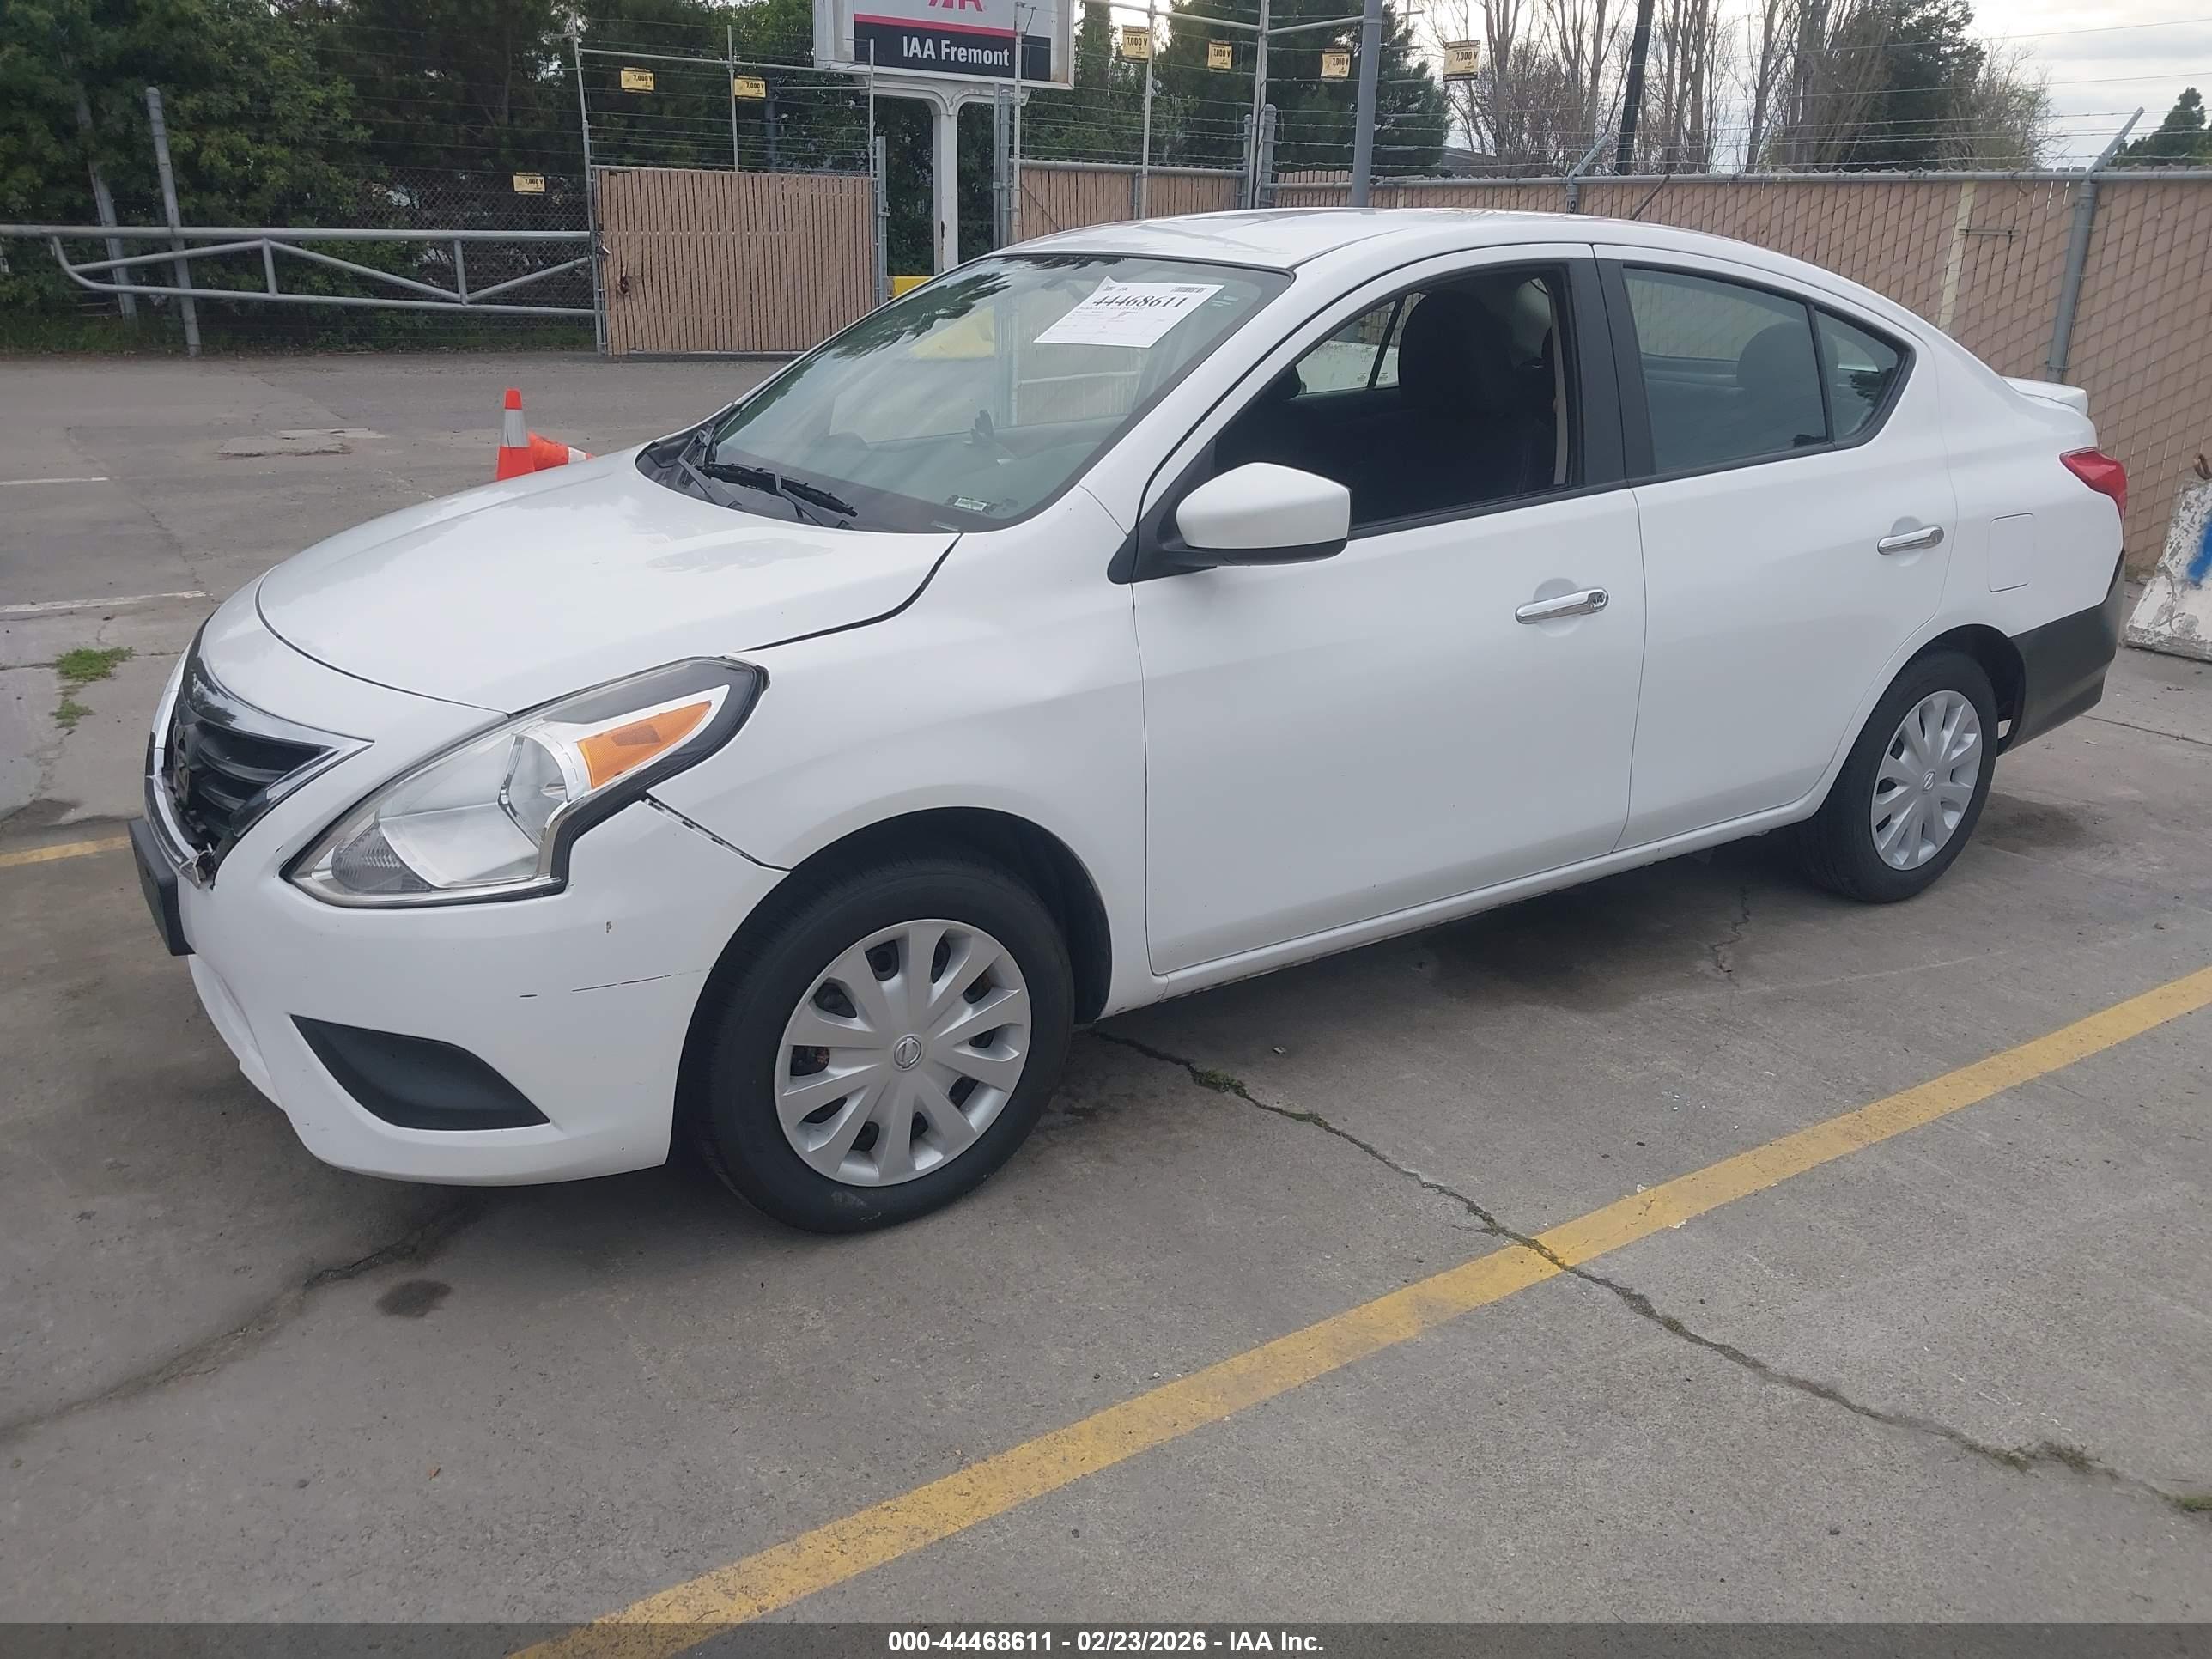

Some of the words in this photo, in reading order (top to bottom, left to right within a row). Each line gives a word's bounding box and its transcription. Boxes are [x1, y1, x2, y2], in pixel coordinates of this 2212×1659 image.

[902, 36, 936, 60] IAA
[941, 40, 1010, 67] Fremont
[1332, 57, 1346, 66] 7,000
[1455, 52, 1473, 62] 7,000
[633, 74, 648, 82] 7,000
[1092, 295, 1189, 307] 44468611
